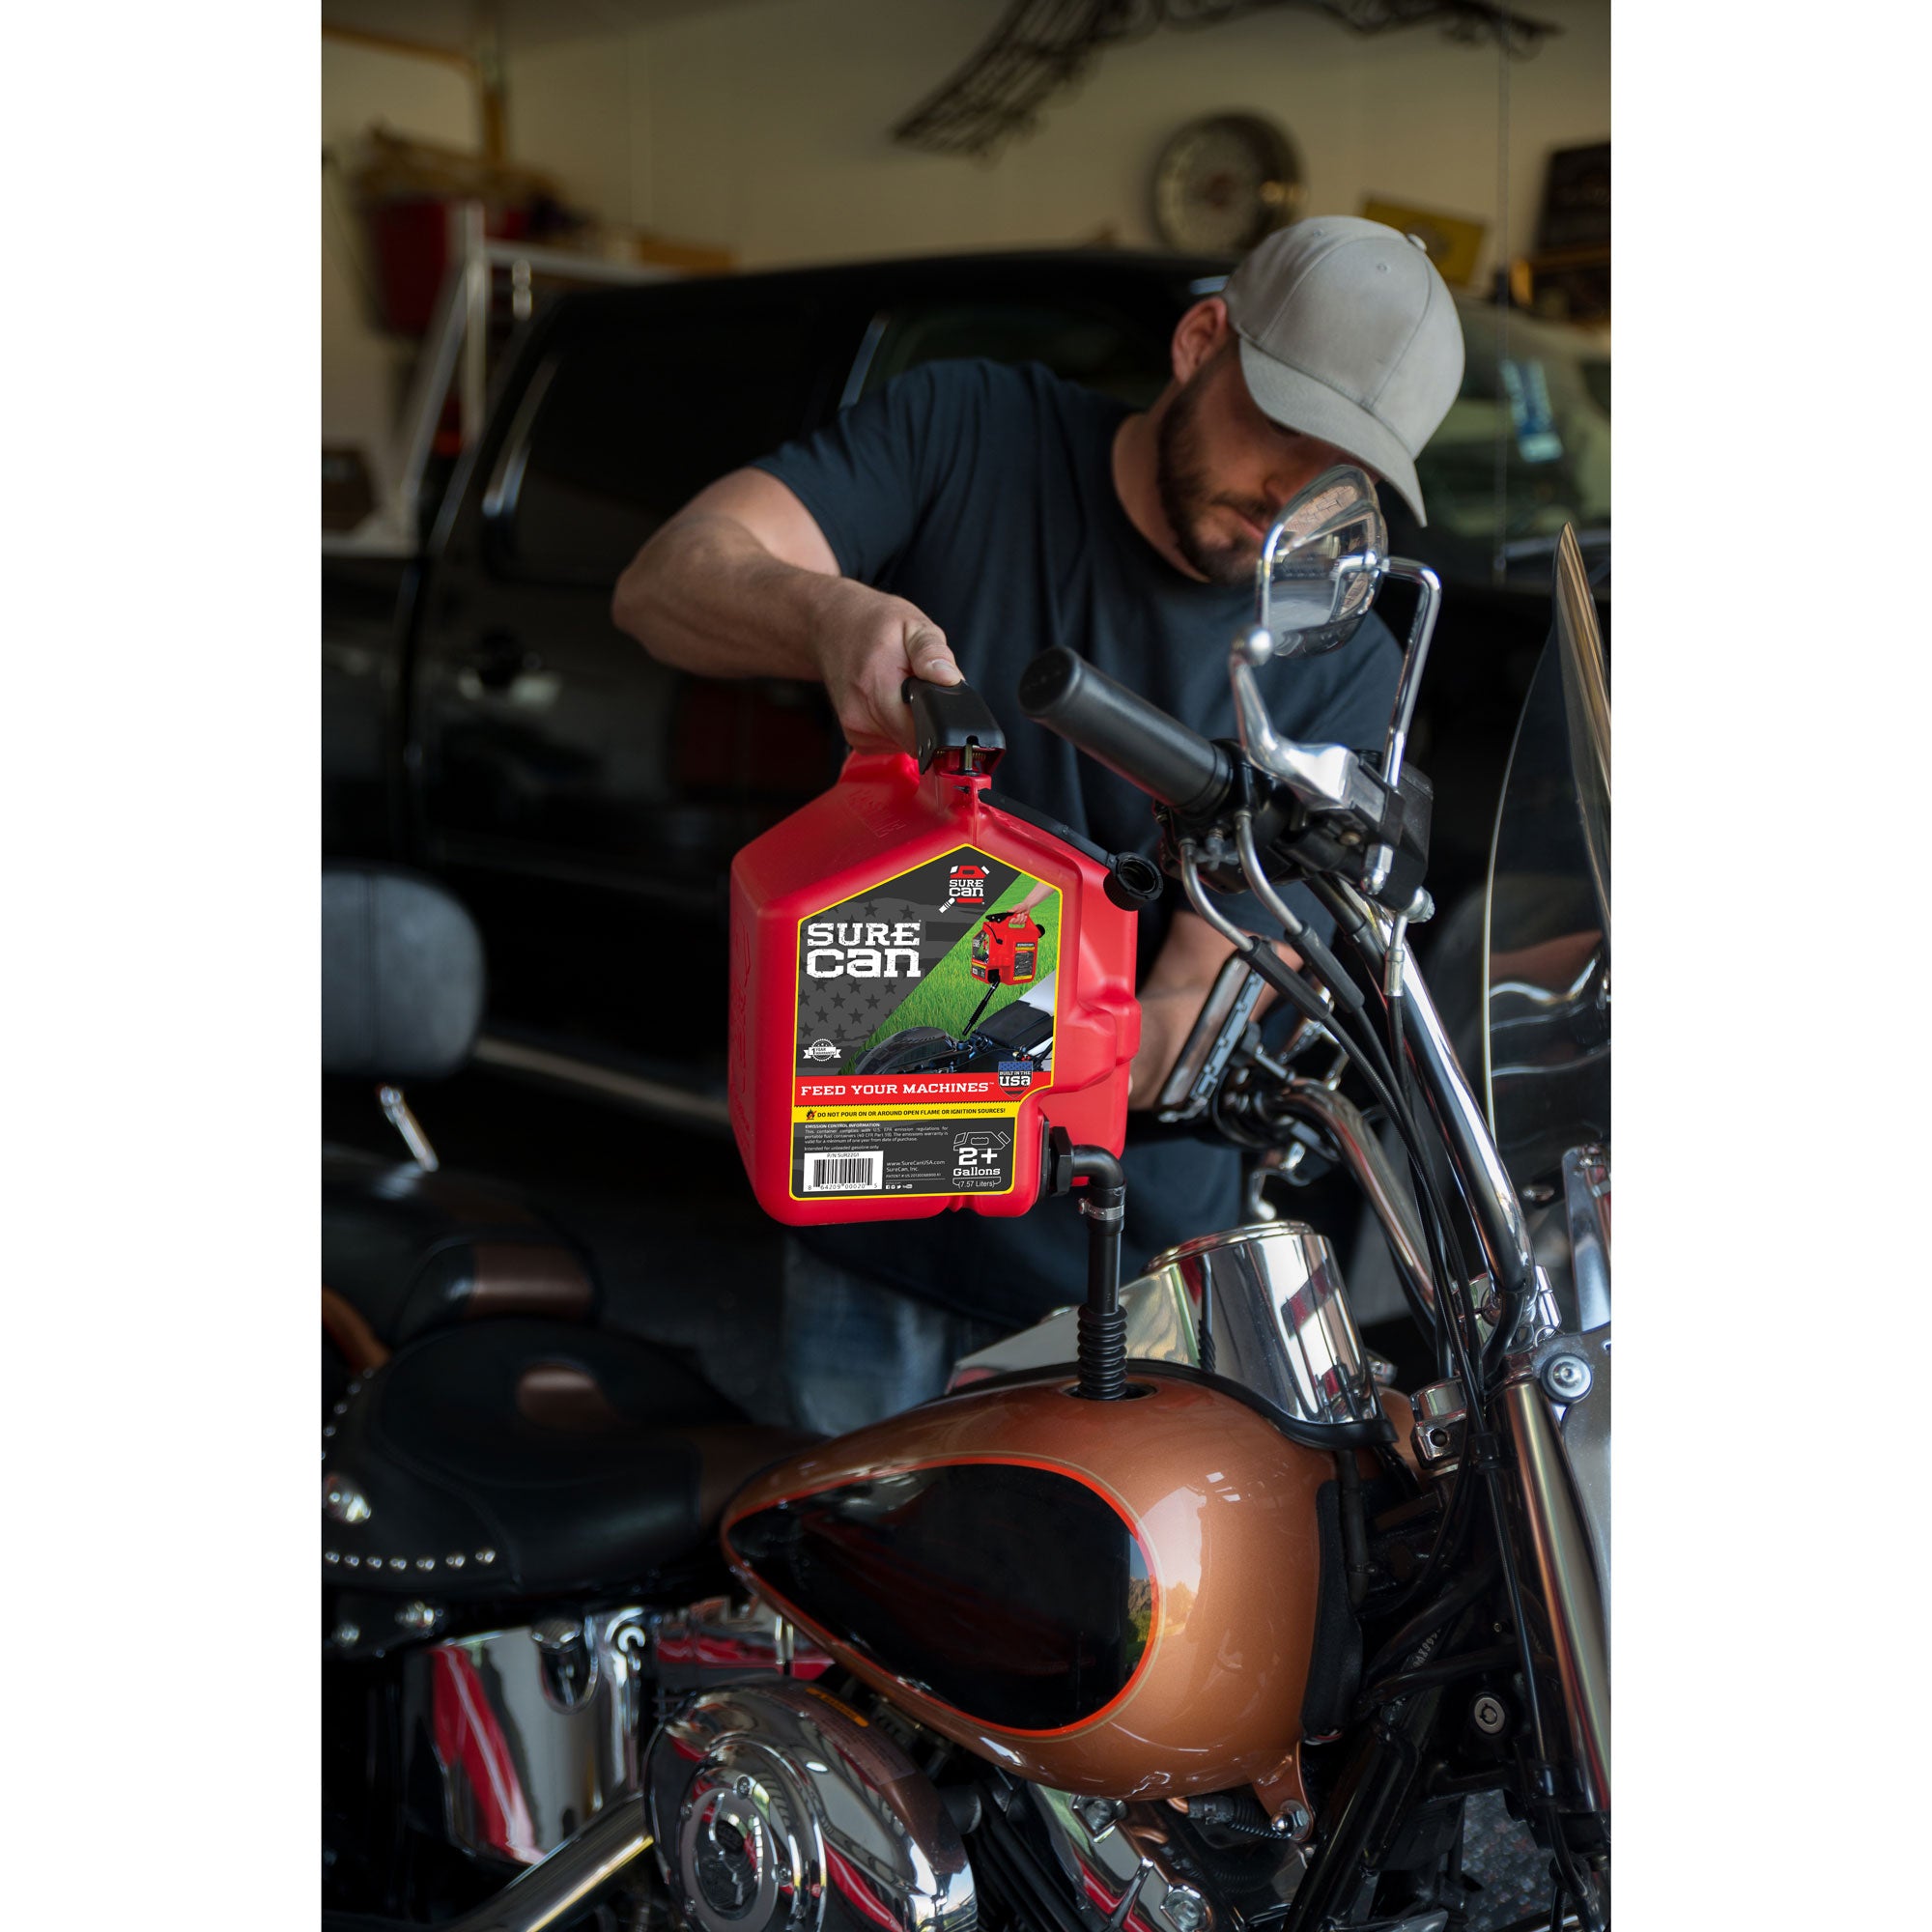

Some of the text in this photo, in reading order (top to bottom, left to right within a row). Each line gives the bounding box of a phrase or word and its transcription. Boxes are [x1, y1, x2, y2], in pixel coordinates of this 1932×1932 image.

[949, 879, 984, 888] SURE
[807, 923, 921, 946] SURE
[801, 1085, 846, 1096] FEED
[851, 1084, 898, 1094] YOUR
[958, 1147, 998, 1166] 2+
[952, 1166, 1001, 1177] Gallons
